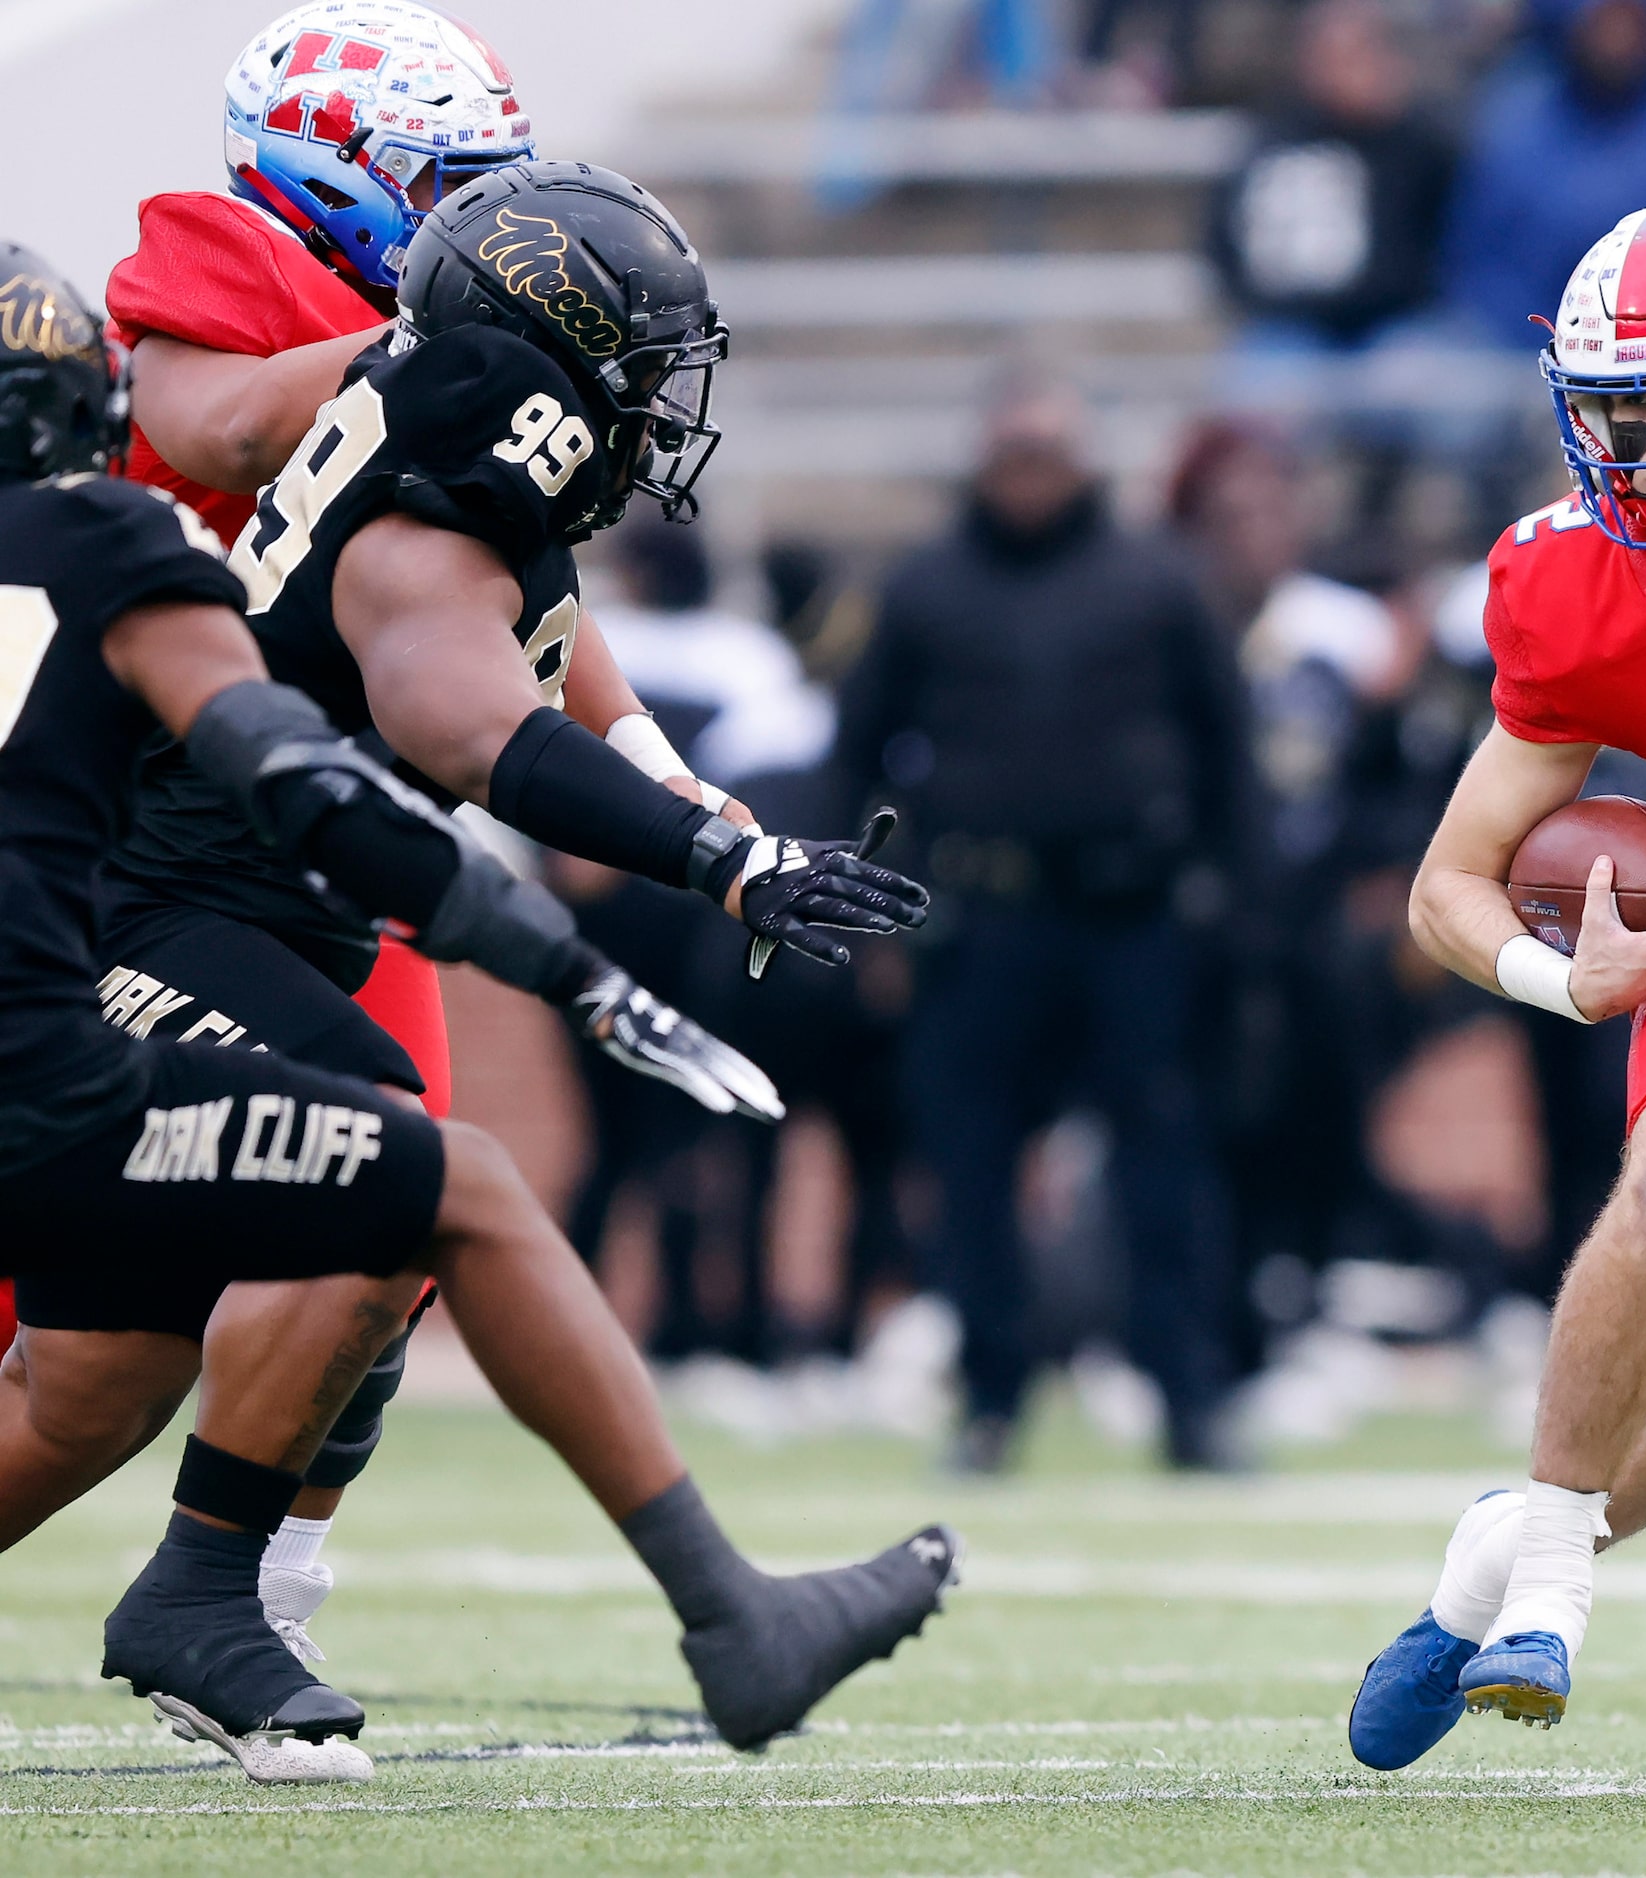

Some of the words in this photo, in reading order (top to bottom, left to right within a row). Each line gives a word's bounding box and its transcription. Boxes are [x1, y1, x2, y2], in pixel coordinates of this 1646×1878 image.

[364, 27, 387, 36] FEAST
[390, 79, 410, 93] 22
[376, 110, 399, 124] FEAST
[406, 118, 424, 130] 22
[433, 133, 452, 146] DLT
[458, 129, 474, 142] DLT
[1601, 268, 1618, 280] DLT
[478, 208, 622, 357] Mecca
[1582, 318, 1601, 329] FIGHT
[1565, 338, 1580, 350] FIGHT
[1583, 339, 1603, 352] FIGHT
[492, 392, 595, 497] 99
[122, 1095, 234, 1183] OAK
[231, 1094, 382, 1187] CLIFF
